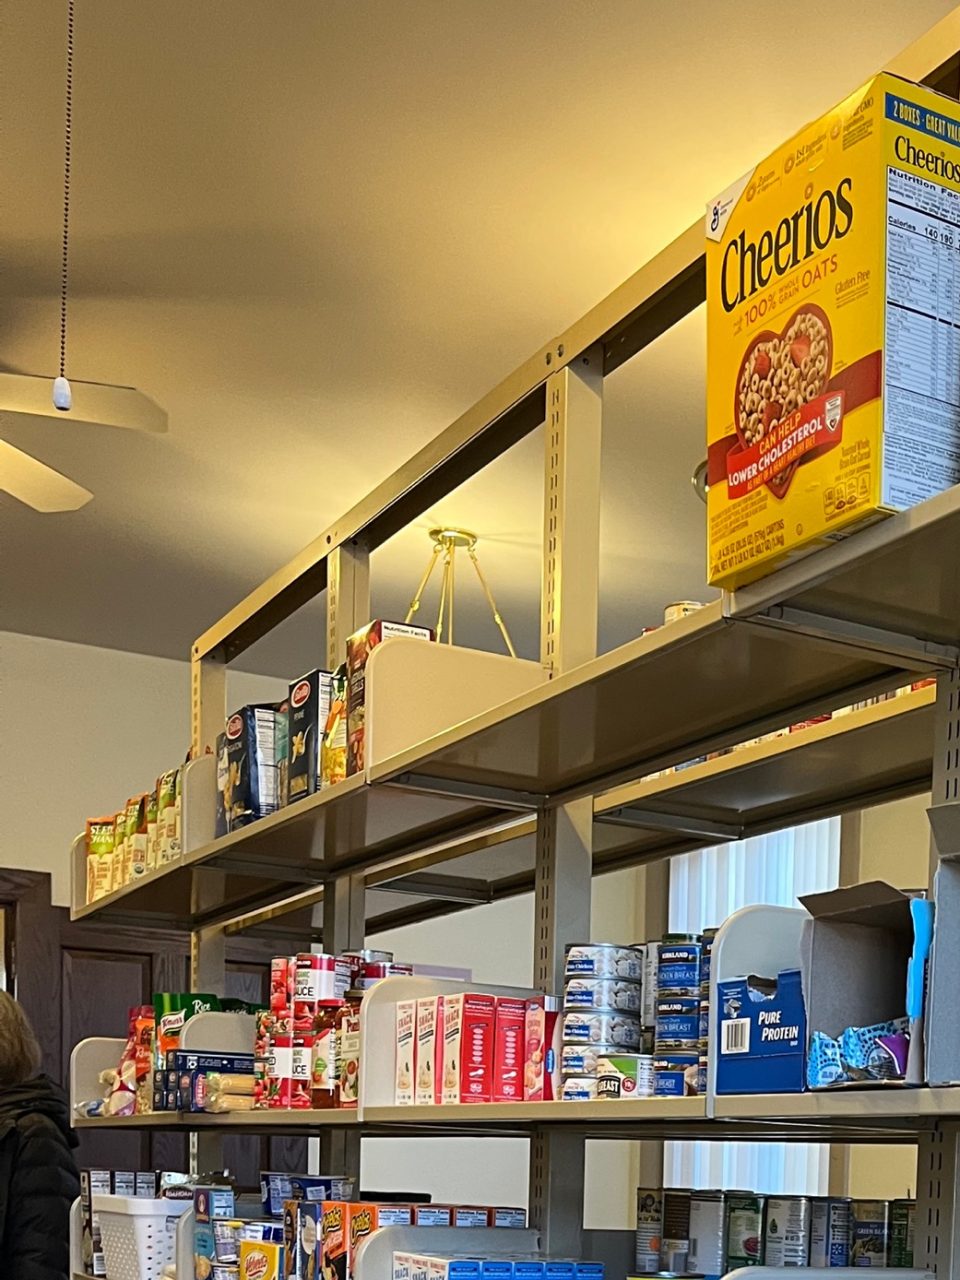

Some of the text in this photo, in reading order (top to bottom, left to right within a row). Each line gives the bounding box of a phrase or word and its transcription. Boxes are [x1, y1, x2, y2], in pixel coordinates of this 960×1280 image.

[893, 100, 898, 112] 2
[899, 103, 920, 127] BOXES
[926, 114, 947, 136] GREAT
[888, 167, 937, 192] Nutrition
[888, 215, 917, 232] Calories
[925, 226, 939, 240] 140
[940, 233, 954, 246] 190
[721, 177, 853, 313] Cheerios
[744, 254, 838, 326] 100% WHOLE GRAIN OATS
[834, 269, 871, 296] Gluten Free
[759, 412, 802, 455] CAN HELP
[728, 465, 757, 487] LOWER
[758, 417, 823, 472] CHOLESTEROL
[662, 951, 688, 960] KIRKLAND
[673, 970, 699, 980] BREAST
[192, 999, 212, 1014] Rice
[758, 1010, 782, 1027] PURE
[668, 1023, 691, 1033] BREAST
[761, 1025, 800, 1042] PROTEIN
[395, 1267, 409, 1279] SNACK
